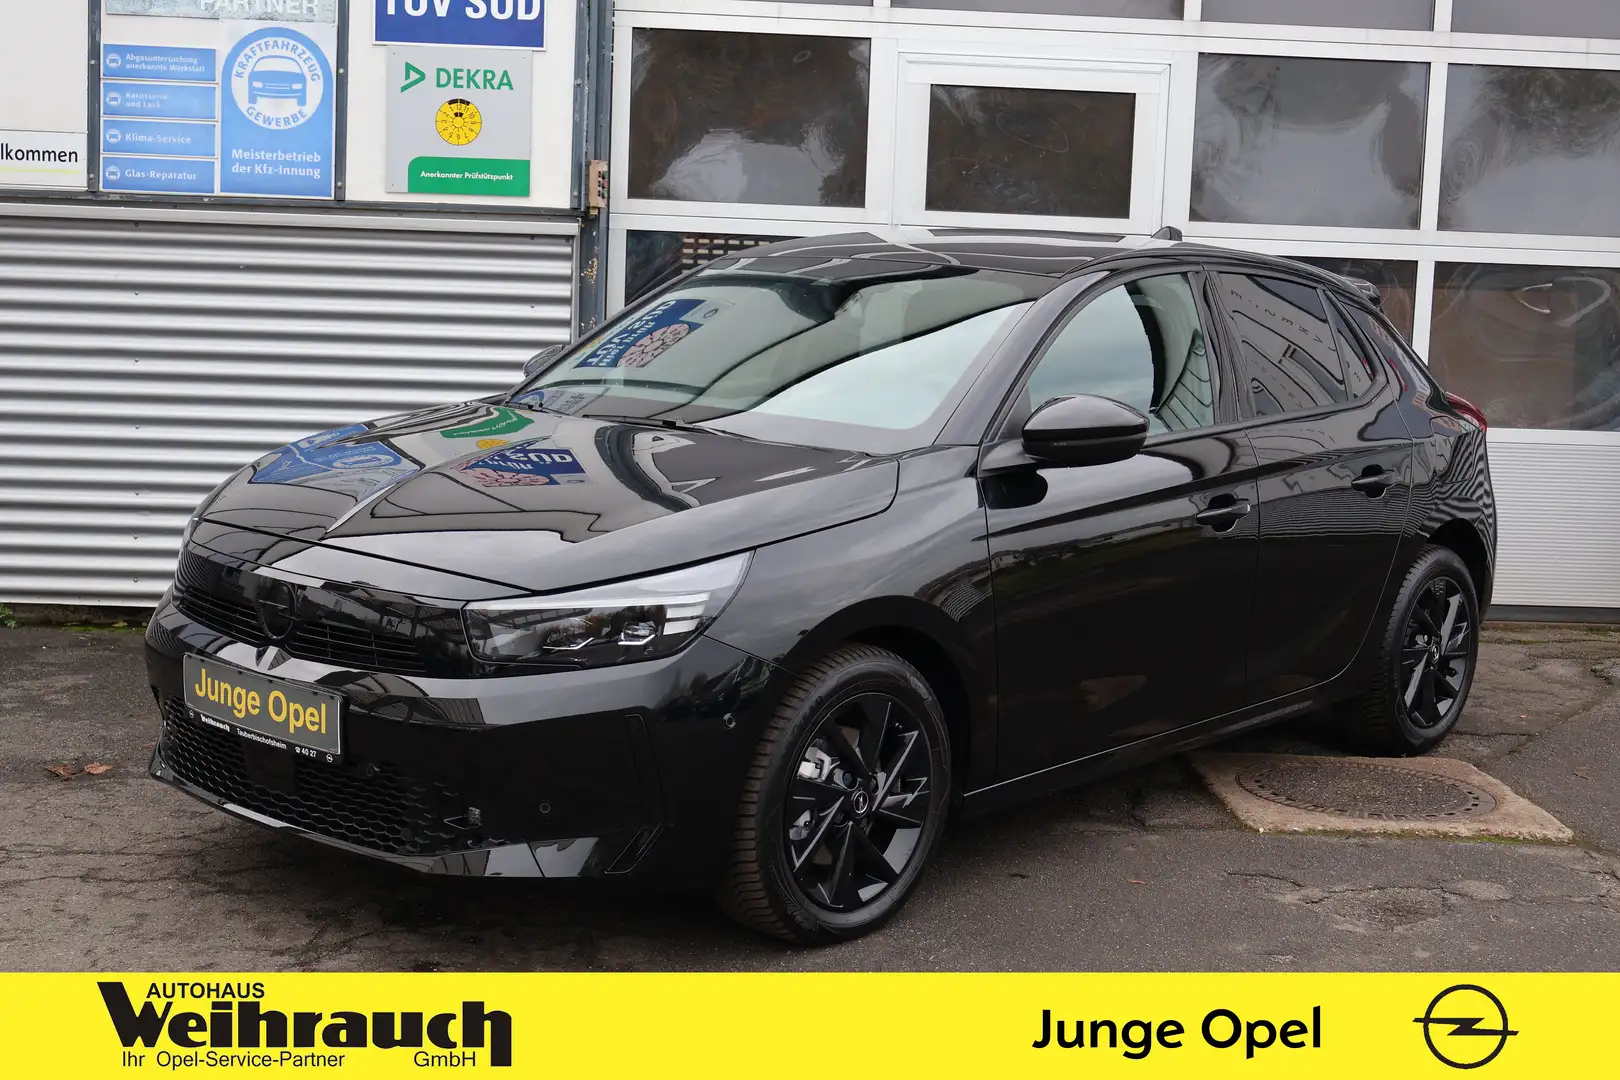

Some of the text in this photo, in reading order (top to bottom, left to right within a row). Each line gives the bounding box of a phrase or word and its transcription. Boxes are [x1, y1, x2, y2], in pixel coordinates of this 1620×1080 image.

[125, 53, 198, 64] Abgasuntersuchung
[235, 40, 320, 82] KRAFTFAHRZEUG
[169, 64, 205, 73] Werkstatt
[436, 67, 514, 90] DEKRA
[246, 106, 307, 127] GEWERBE
[125, 133, 192, 144] Klima-Service
[0, 142, 78, 163] lkommen
[231, 148, 321, 162] Meisterbetrieb
[231, 162, 252, 173] der
[420, 170, 514, 182] Anerkannter Prüfstützpunkt
[194, 668, 326, 734] Junge Opel
[236, 727, 287, 750] Tauberbischofsheim
[301, 748, 310, 757] 40
[309, 750, 317, 758] 27
